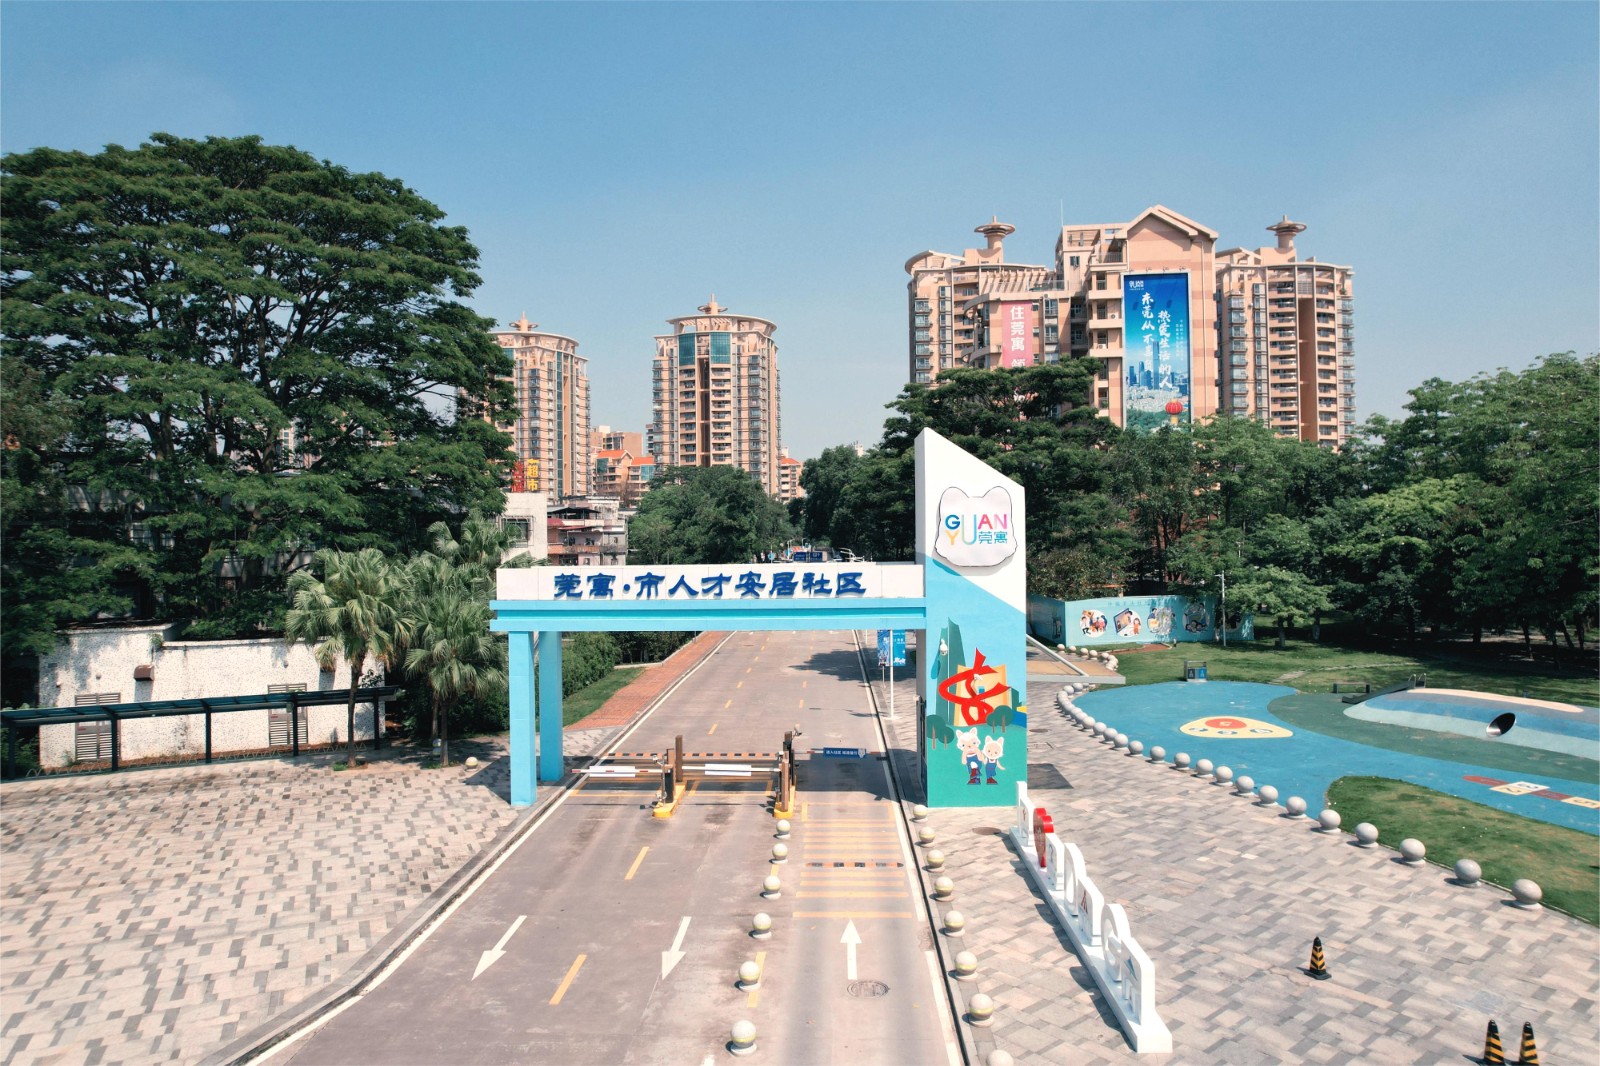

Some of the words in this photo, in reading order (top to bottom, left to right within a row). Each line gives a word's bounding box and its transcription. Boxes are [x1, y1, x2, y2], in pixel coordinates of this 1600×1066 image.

[1010, 305, 1025, 351] 住莞寓
[945, 513, 1008, 545] GUAN
[978, 531, 1008, 544] 莞寓
